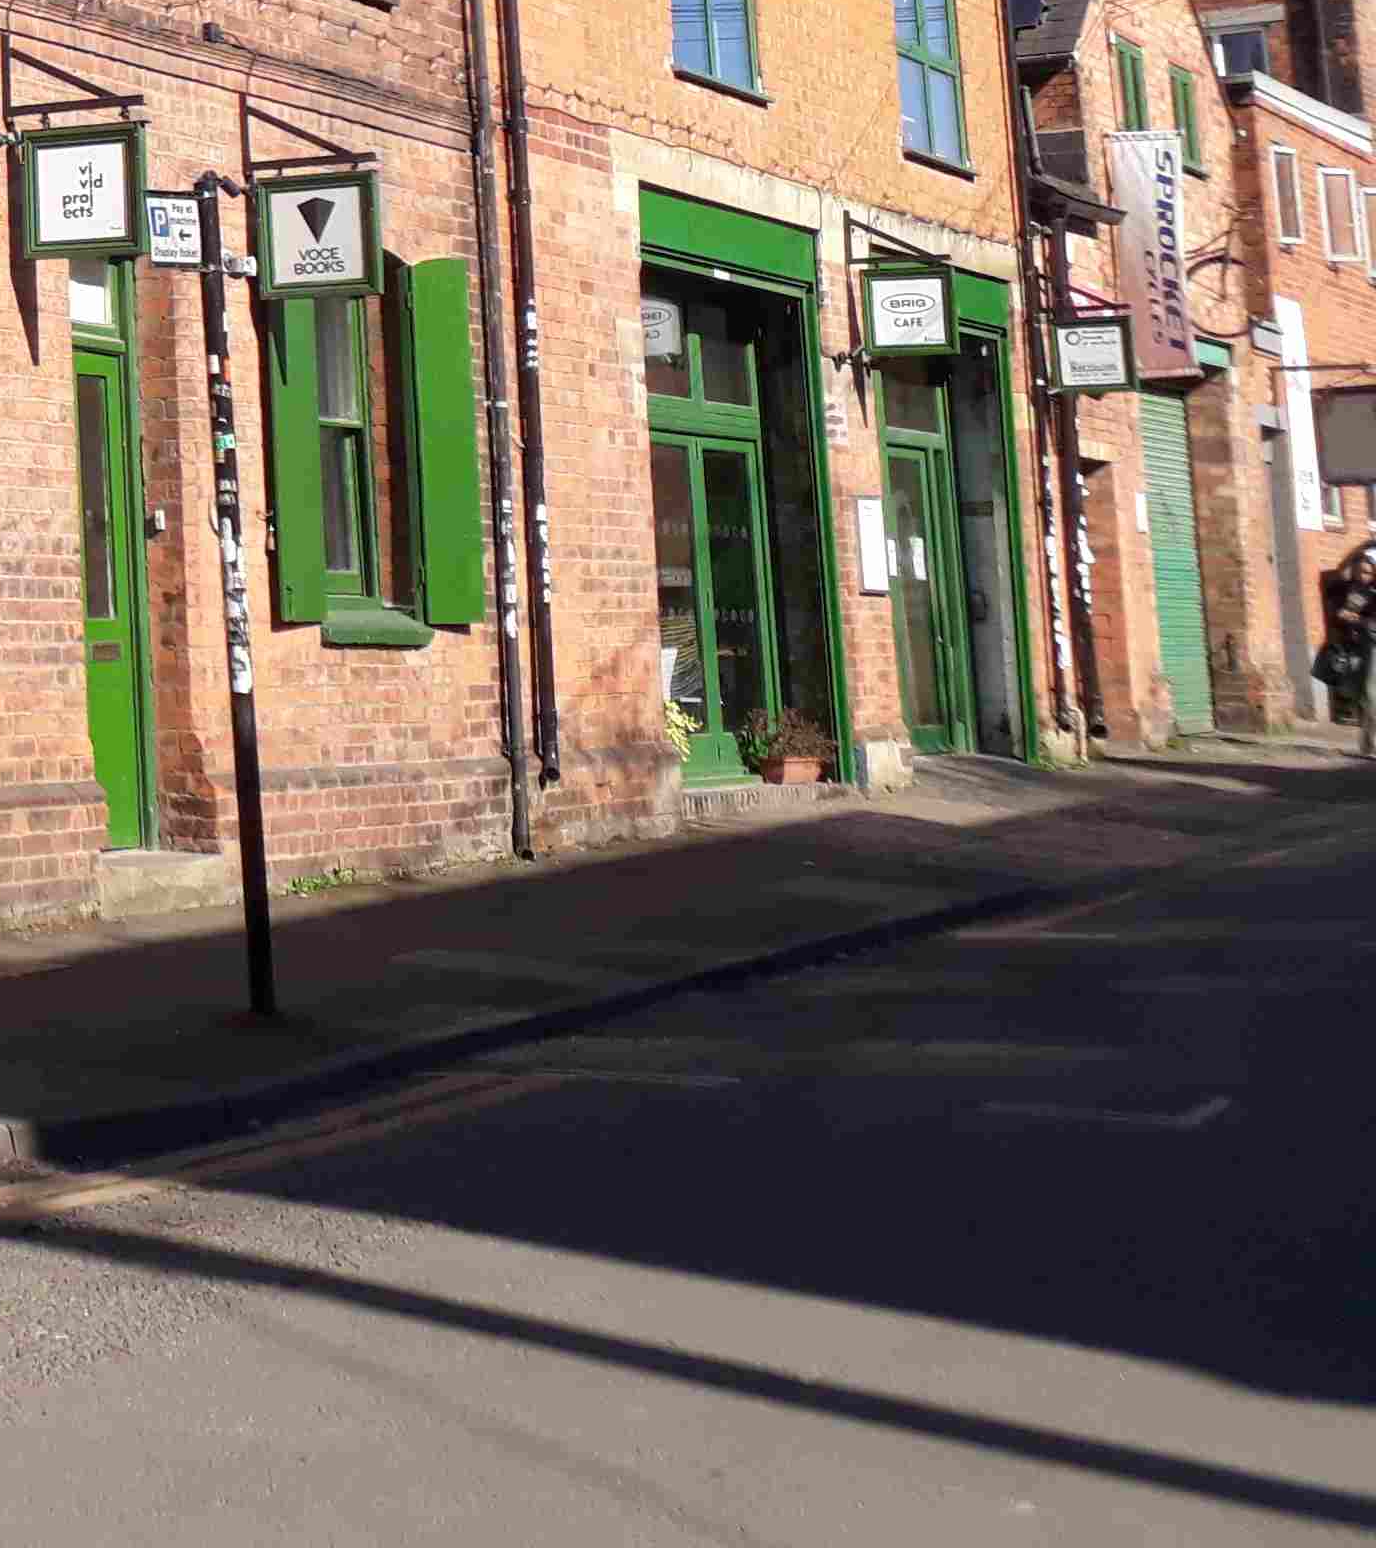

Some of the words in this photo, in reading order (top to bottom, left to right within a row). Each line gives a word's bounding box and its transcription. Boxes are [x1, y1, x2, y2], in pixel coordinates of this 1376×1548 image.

[297, 247, 341, 261] VOCE
[1155, 148, 1187, 351] SPROCKET
[293, 260, 345, 275] BOOKS
[889, 299, 926, 309] BRIG
[893, 317, 923, 328] CAFE
